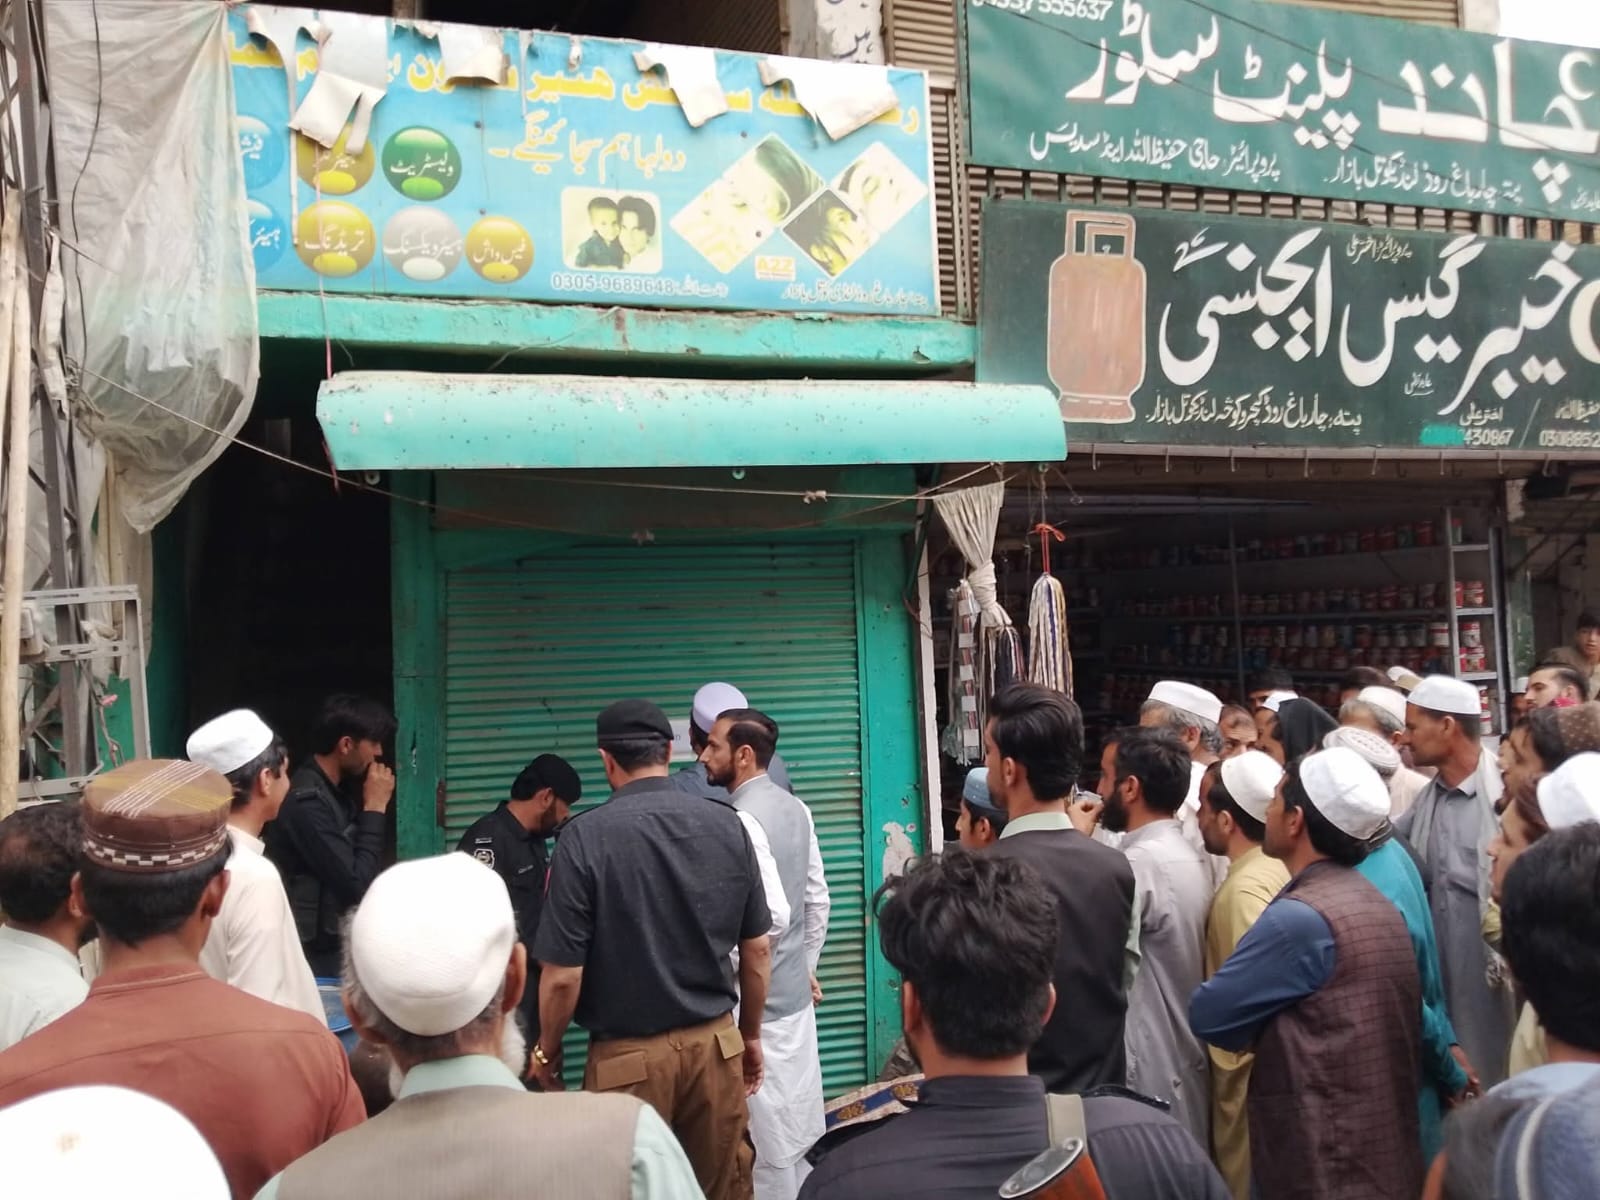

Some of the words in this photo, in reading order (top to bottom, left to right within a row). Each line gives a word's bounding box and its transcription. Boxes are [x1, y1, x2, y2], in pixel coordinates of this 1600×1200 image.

[1065, 0, 1220, 104] سٹور
[241, 133, 263, 159] فیش
[1189, 137, 1220, 170] حاجی
[1377, 38, 1600, 204] چاند
[1422, 163, 1449, 194] روڈ
[551, 272, 674, 295] 0305-9689648
[1338, 232, 1488, 387] گیس
[1437, 240, 1583, 415] خیبر
